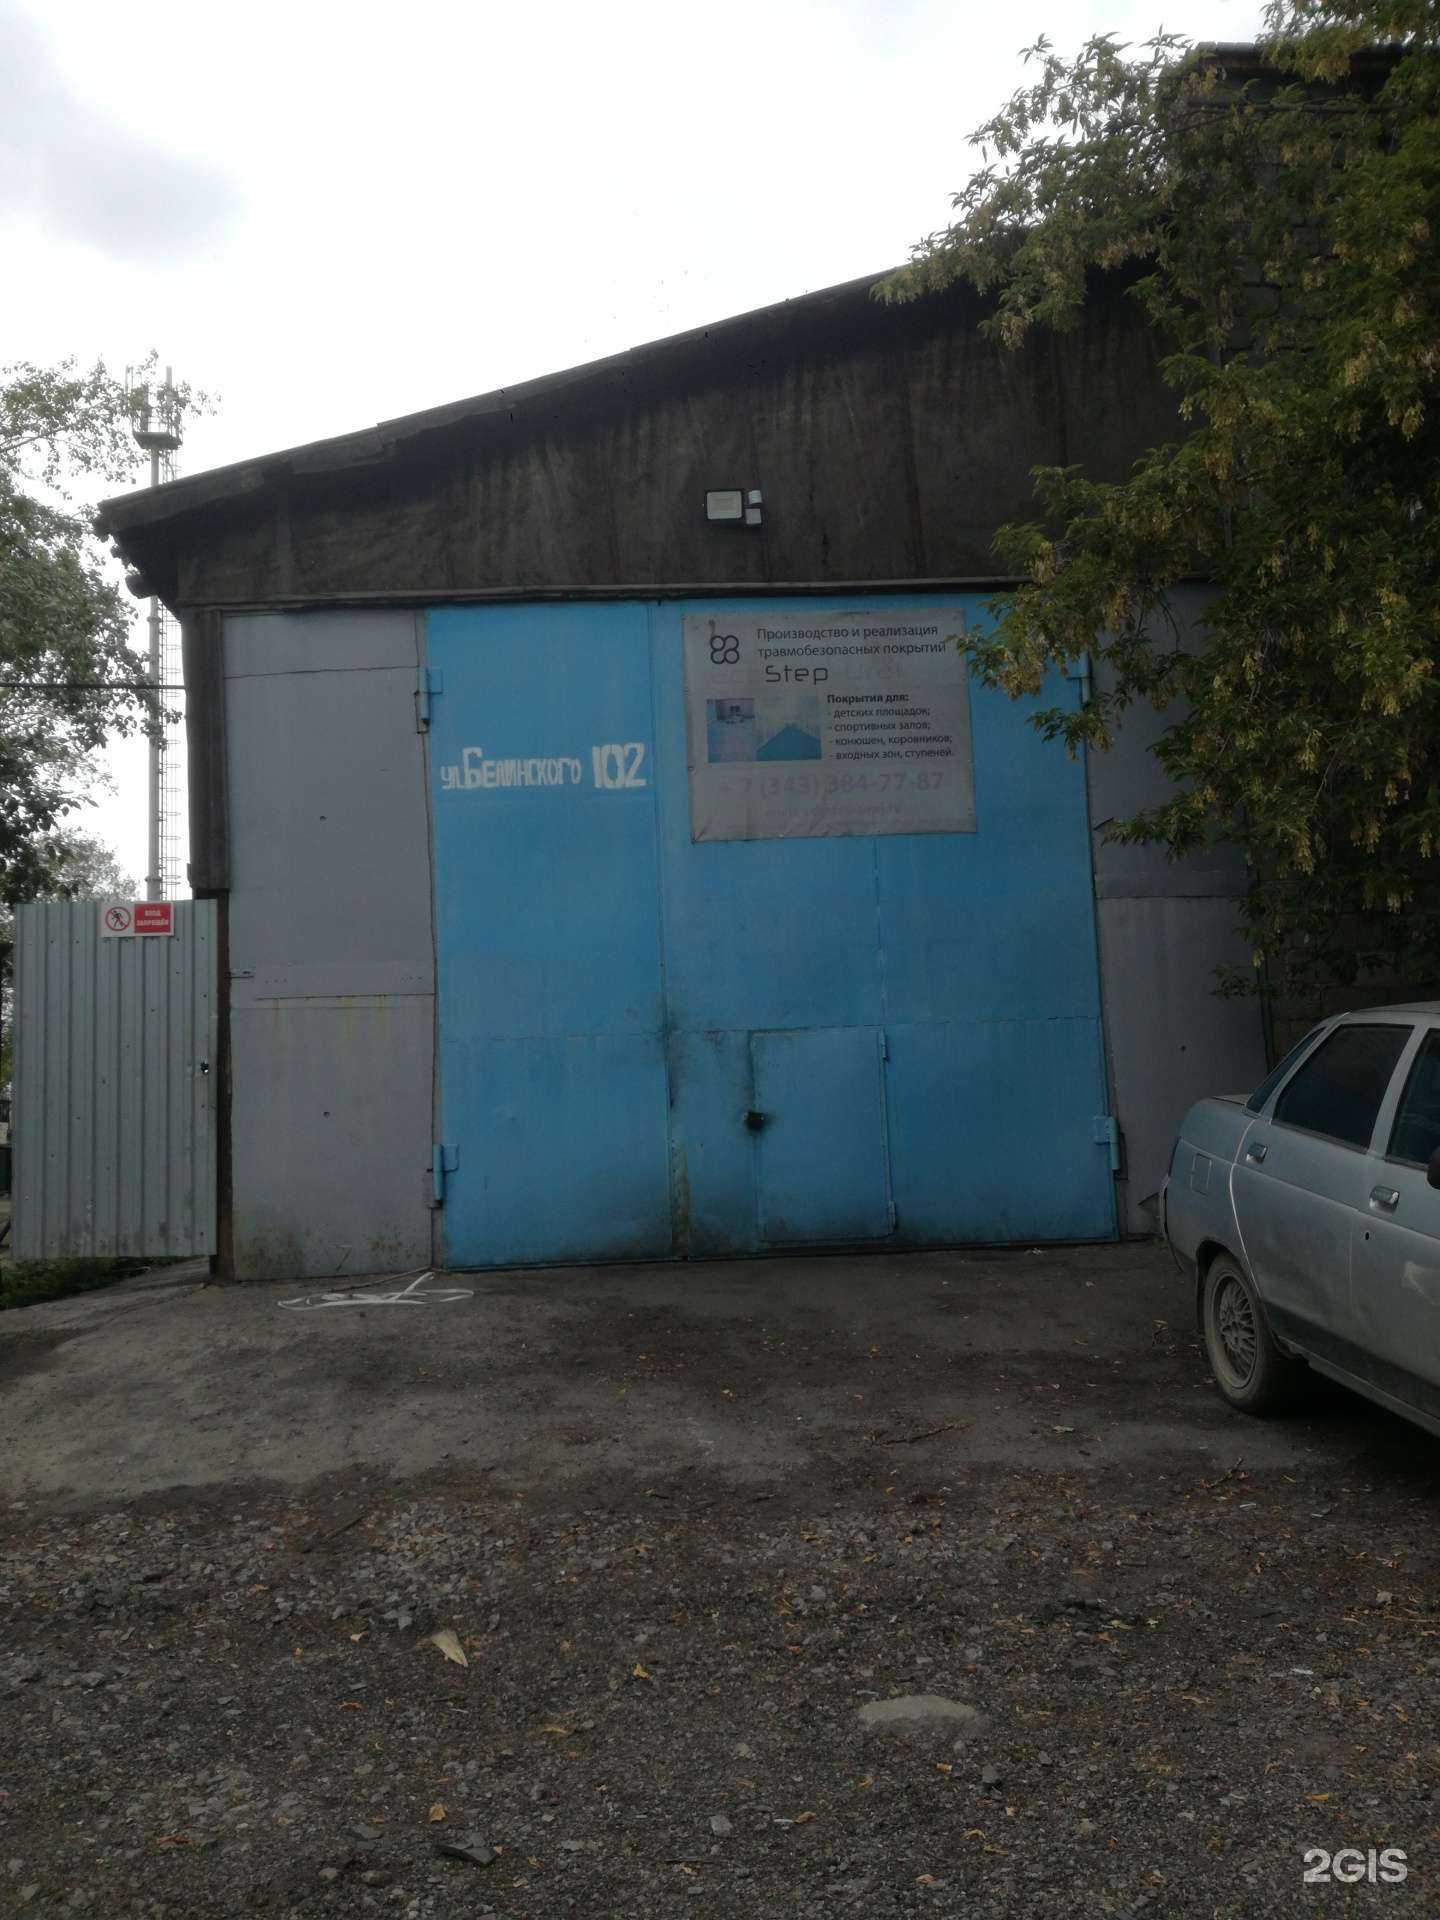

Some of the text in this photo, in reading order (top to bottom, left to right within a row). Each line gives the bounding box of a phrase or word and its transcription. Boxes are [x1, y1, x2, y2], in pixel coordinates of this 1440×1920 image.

[757, 625, 938, 641] Производство и реализация
[759, 640, 946, 659] травмобезопасных покрытий
[765, 664, 828, 685] Step
[827, 693, 910, 705] Покрытия для:
[833, 709, 873, 719] детских
[834, 722, 896, 733] спортивных
[836, 750, 880, 761] входных
[592, 742, 647, 789] 102
